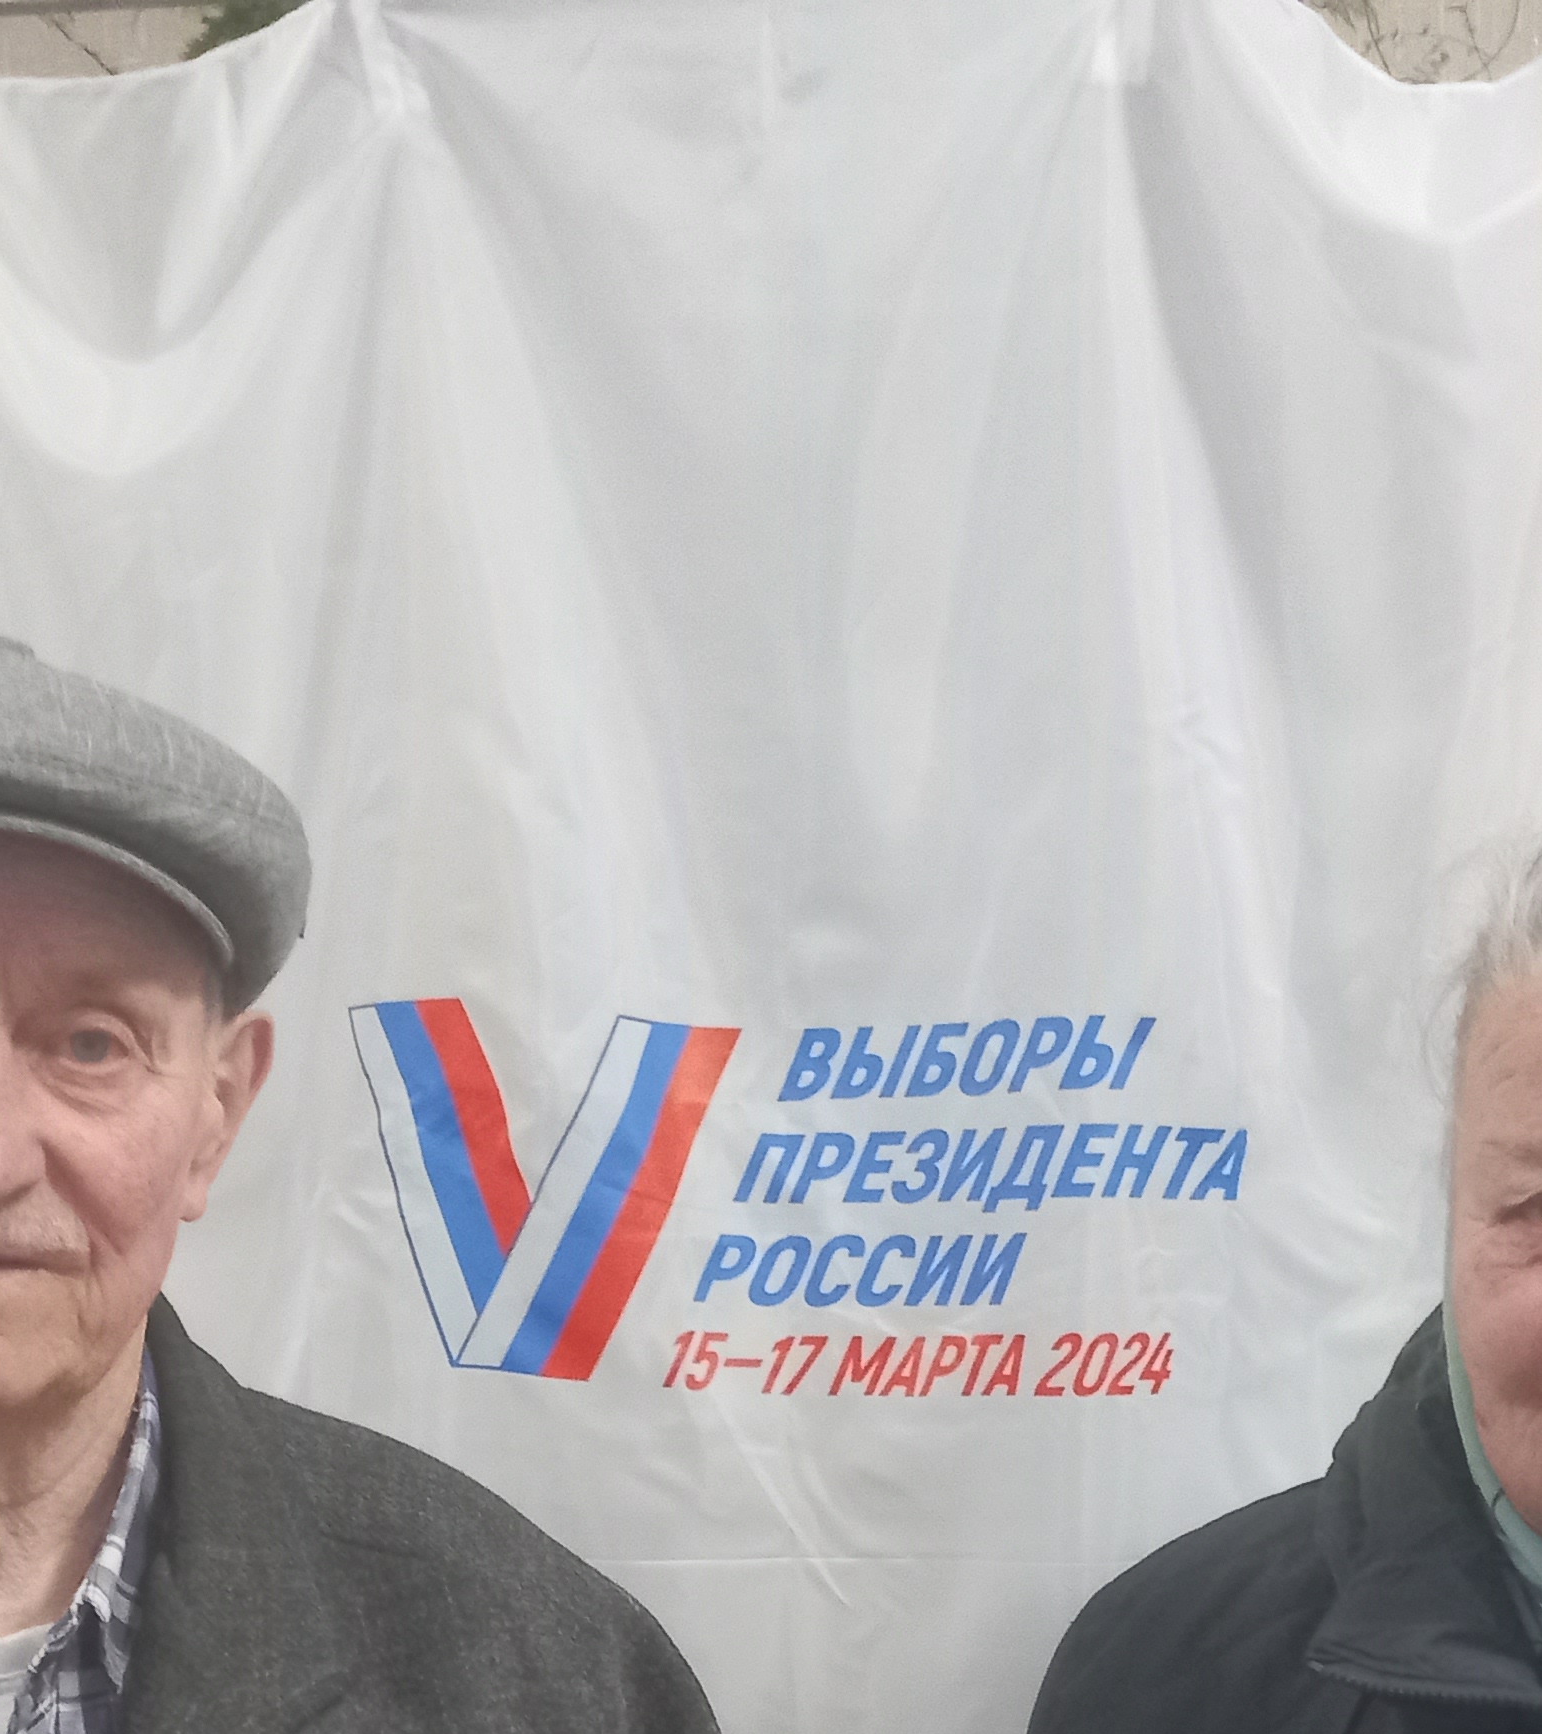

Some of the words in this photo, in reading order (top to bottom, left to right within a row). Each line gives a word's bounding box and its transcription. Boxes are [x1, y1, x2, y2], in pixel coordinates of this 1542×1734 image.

[778, 1014, 1156, 1103] ВЫБОРЫ
[733, 1122, 1249, 1213] ПРЕЗИДЕНТА
[693, 1231, 1027, 1307] РОССИИ
[829, 1333, 1025, 1396] МАРТА
[1034, 1331, 1173, 1397] 2024
